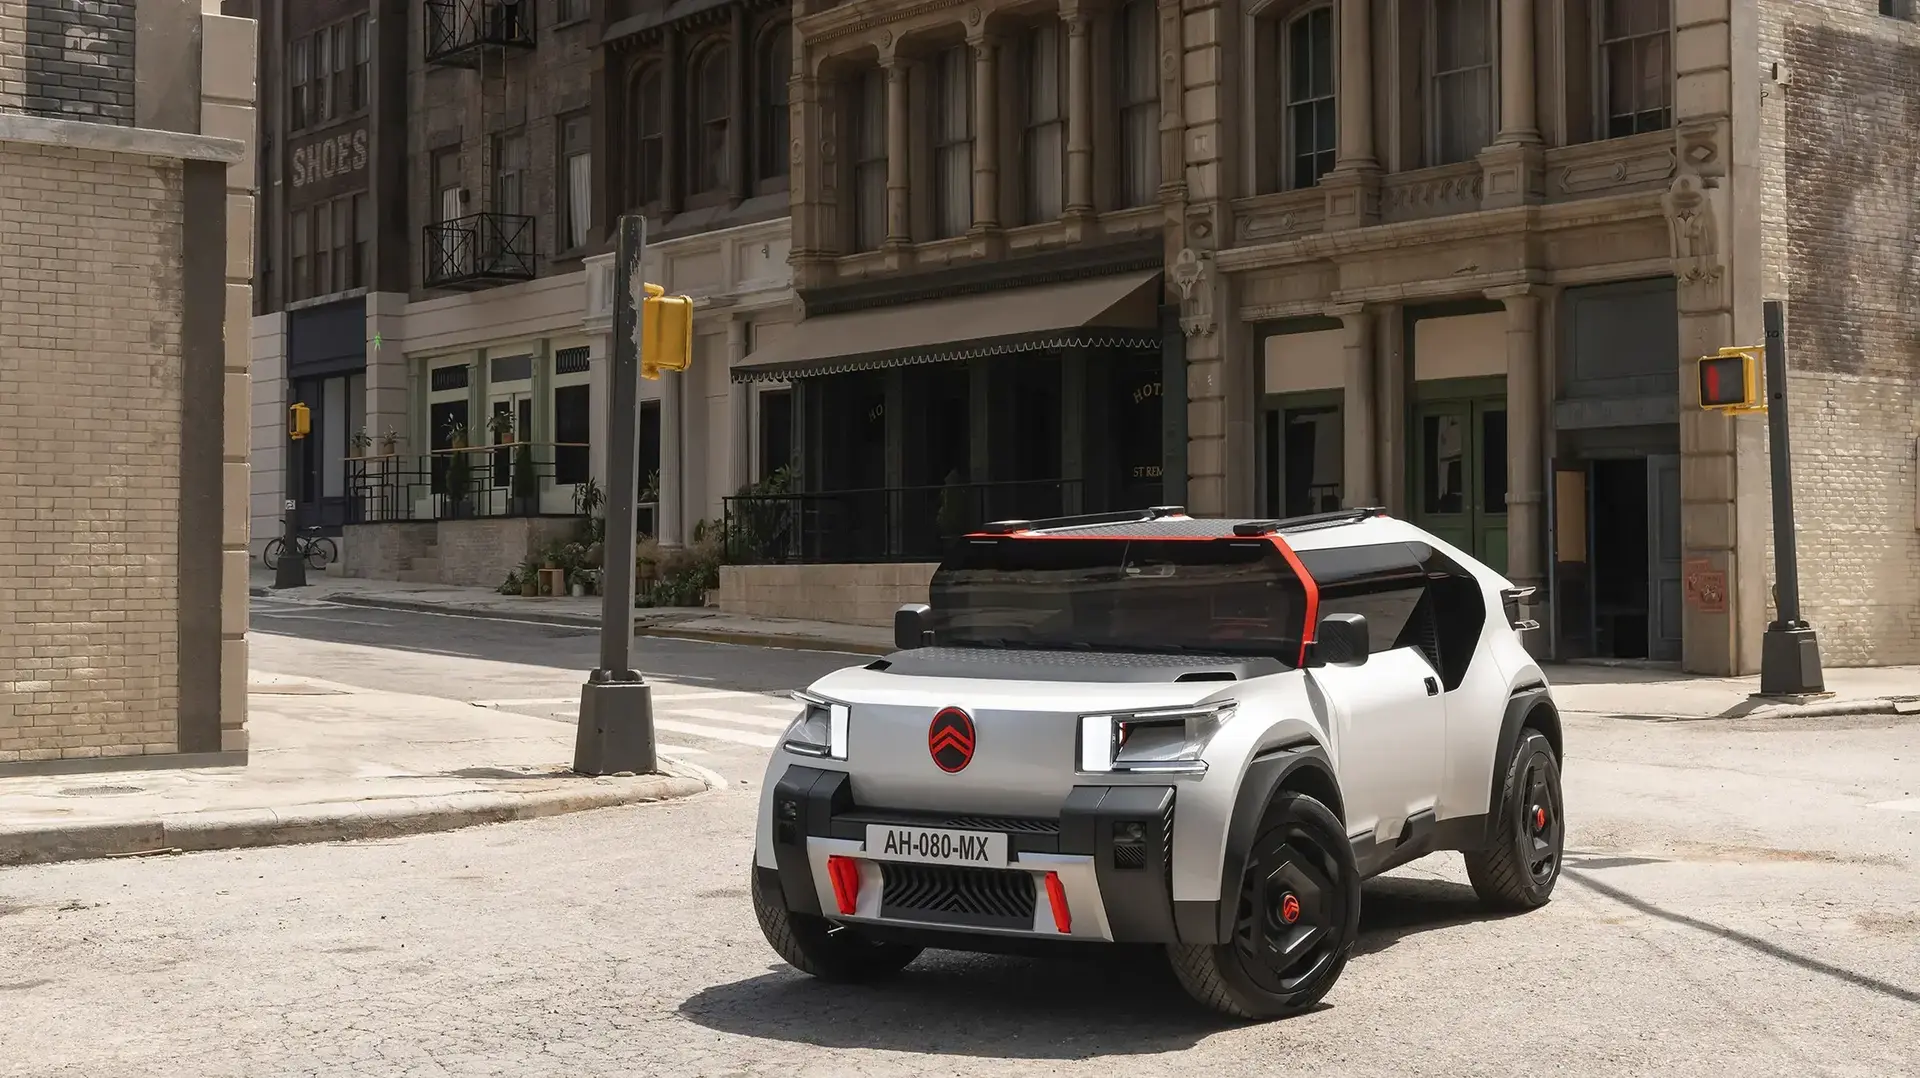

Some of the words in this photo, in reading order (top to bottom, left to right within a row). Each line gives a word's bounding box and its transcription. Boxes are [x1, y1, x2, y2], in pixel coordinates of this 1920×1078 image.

[293, 129, 367, 187] SHOES
[1133, 382, 1164, 404] HOT
[1133, 466, 1145, 477] ST
[884, 830, 989, 861] AH-080-MX
